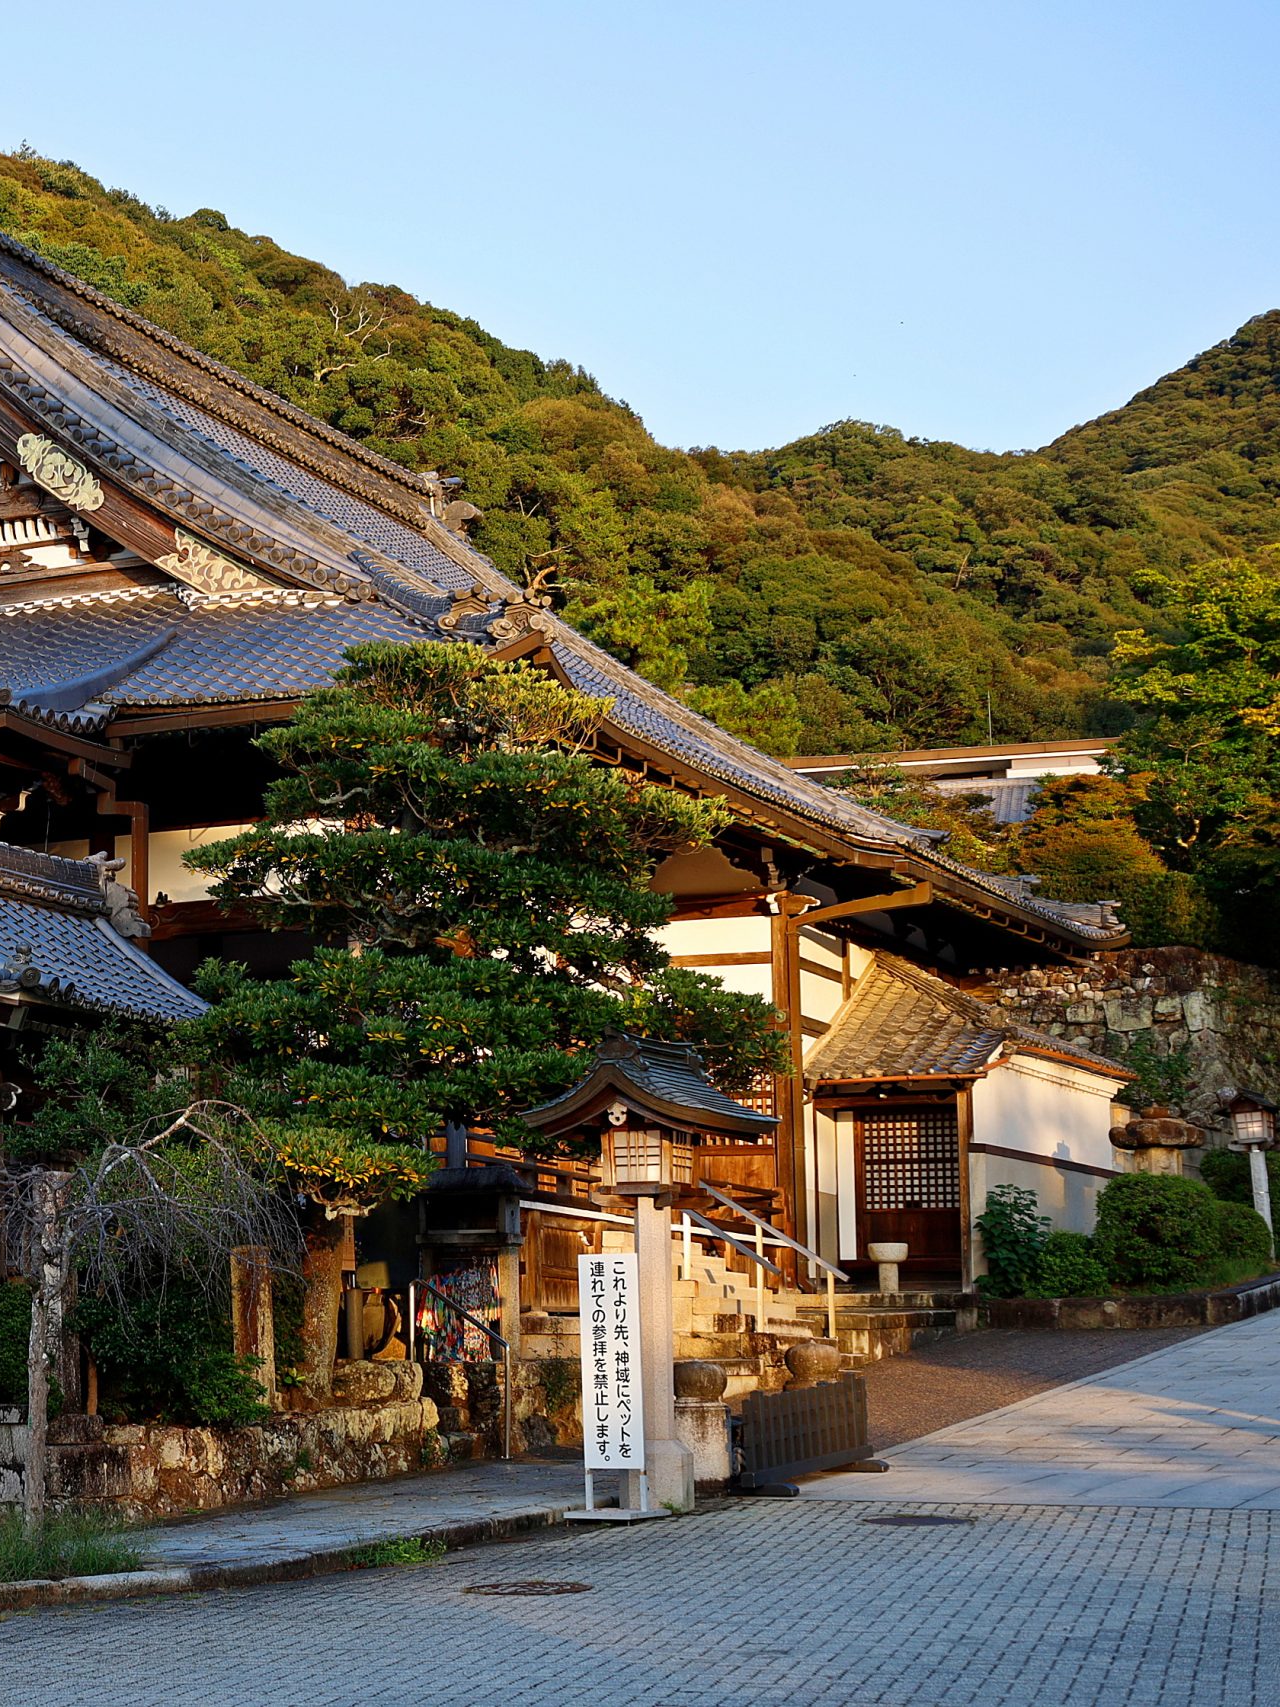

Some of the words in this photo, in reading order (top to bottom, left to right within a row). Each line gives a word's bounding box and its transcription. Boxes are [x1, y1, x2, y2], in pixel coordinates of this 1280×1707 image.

[589, 1261, 611, 1462] 連れての参拝を禁止します。
[613, 1262, 632, 1458] これより先、神域にペットを
